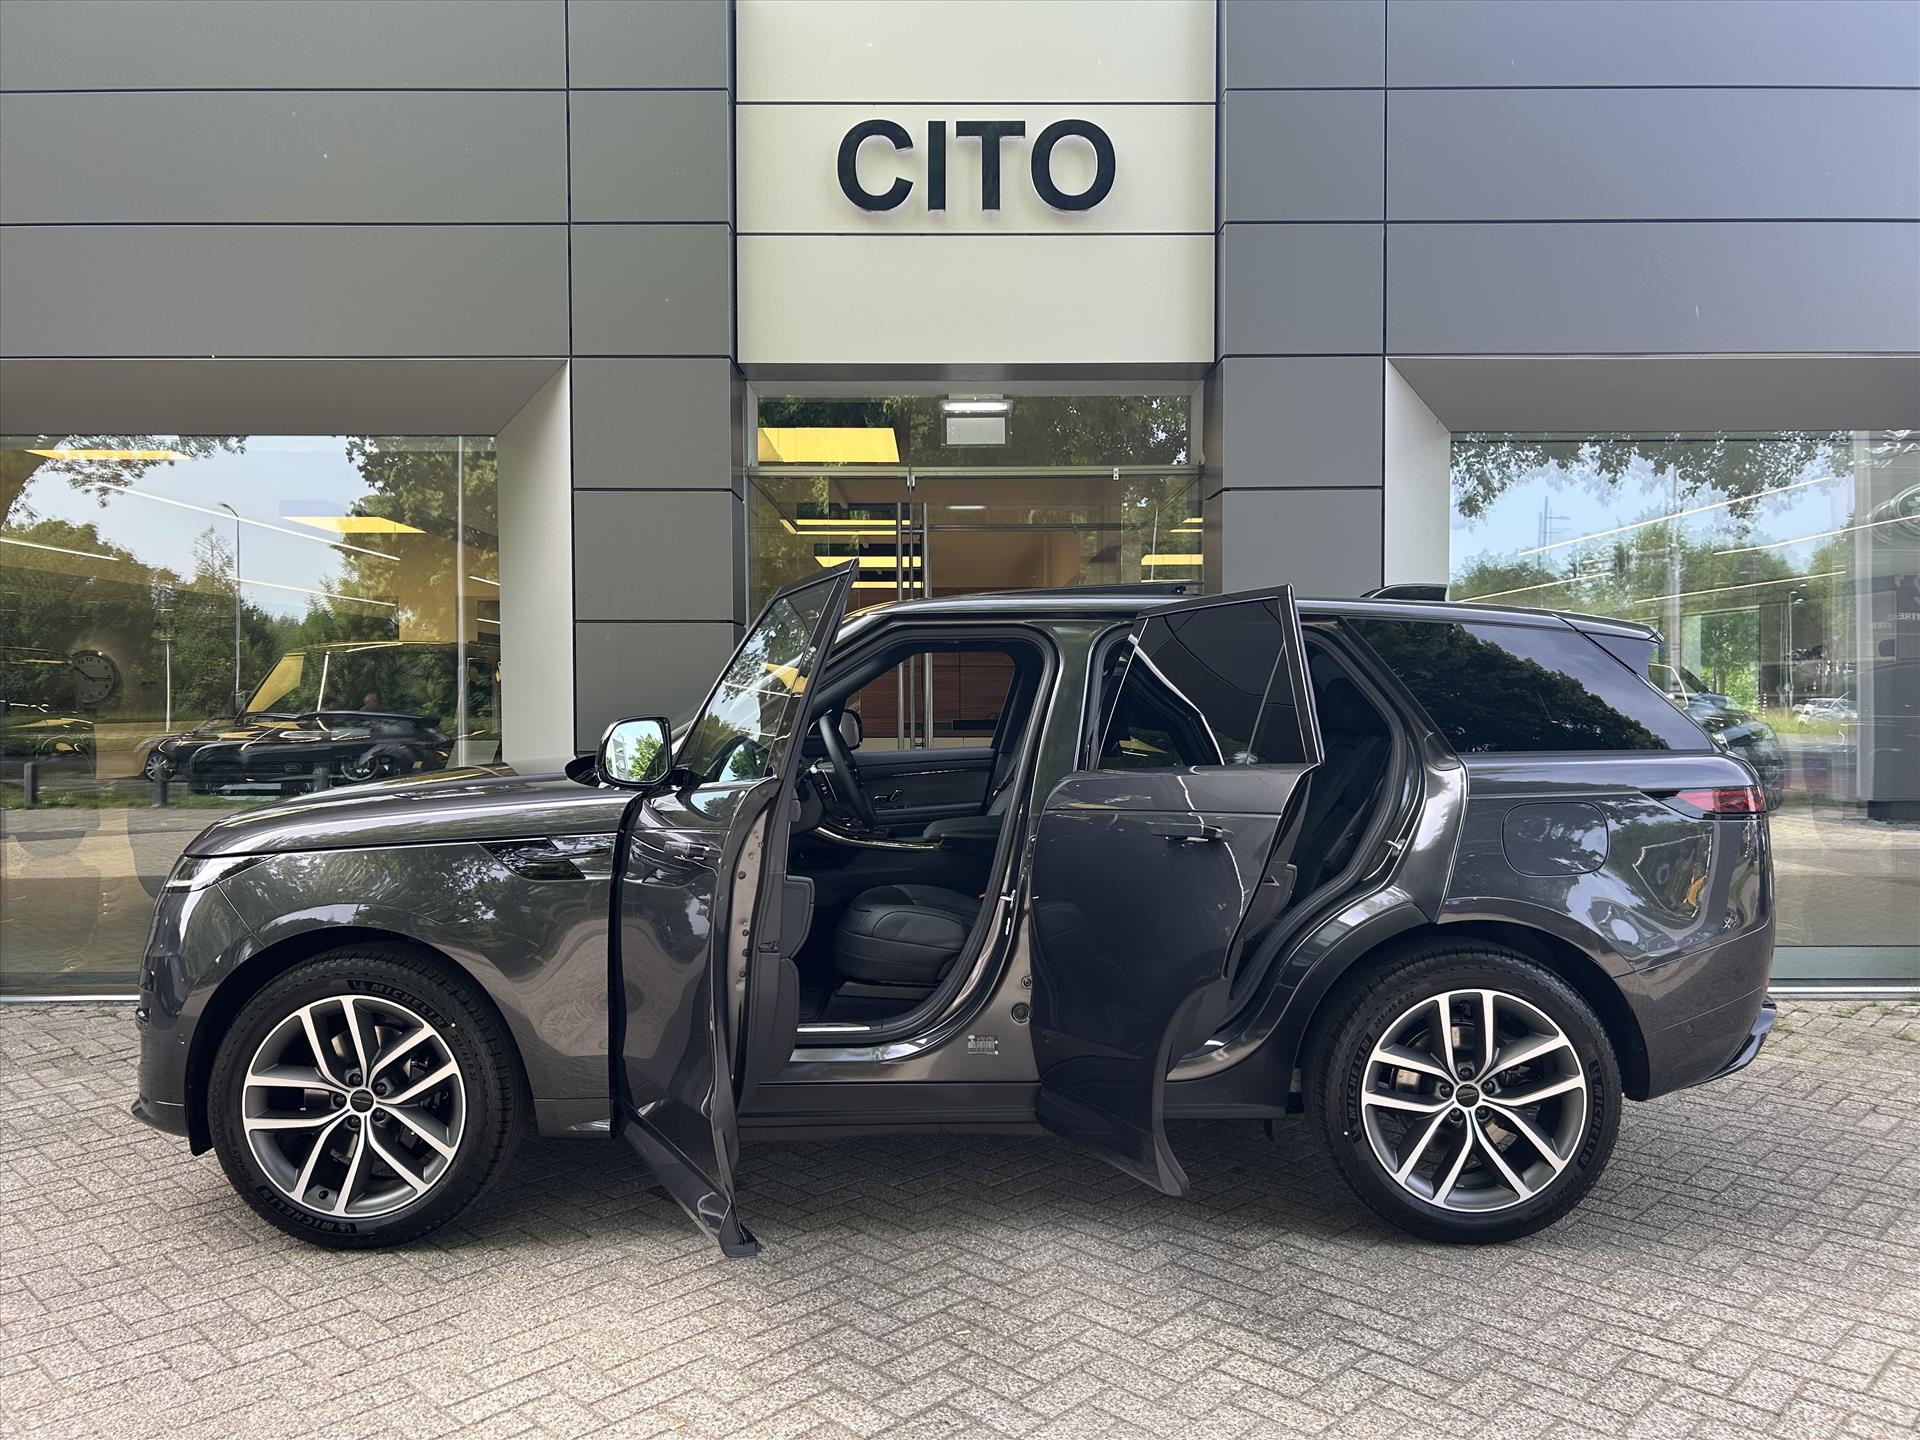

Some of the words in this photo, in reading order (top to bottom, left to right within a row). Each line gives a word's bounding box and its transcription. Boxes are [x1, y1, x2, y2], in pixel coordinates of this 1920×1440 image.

[837, 119, 1116, 212] CITO
[371, 983, 446, 1026] MICHELIN
[1349, 1039, 1371, 1120] MICHELIN
[1580, 1083, 1604, 1167] MICHELIN
[261, 1189, 335, 1231] MICHELIN
